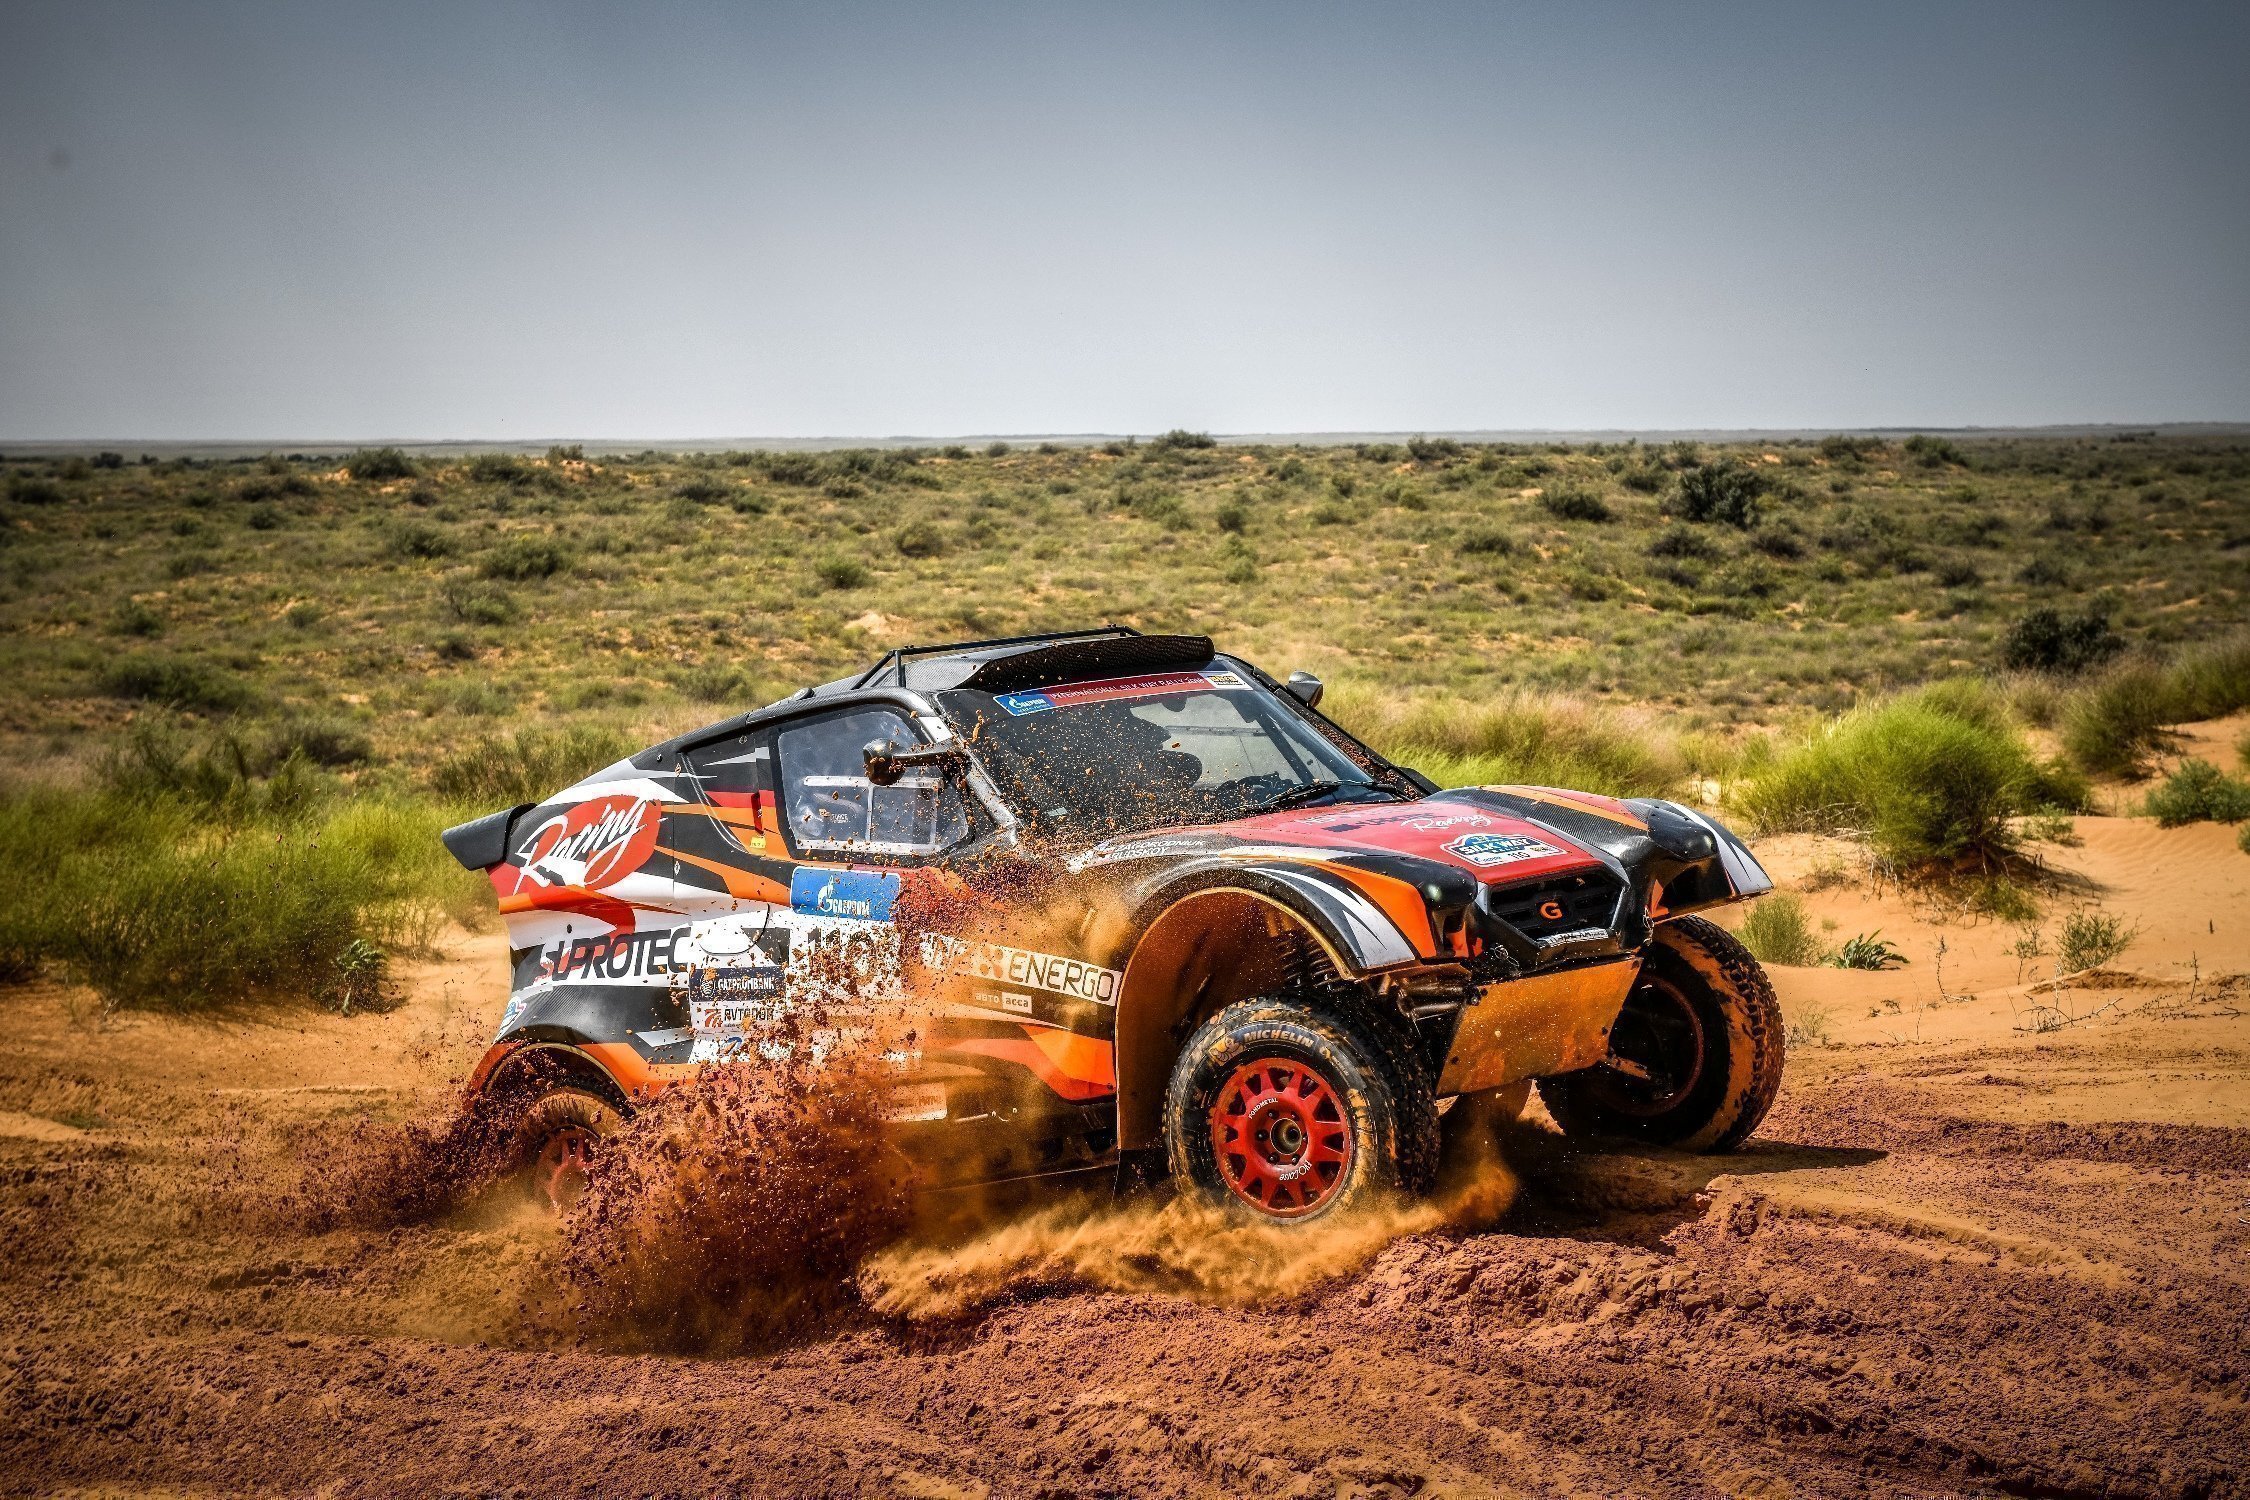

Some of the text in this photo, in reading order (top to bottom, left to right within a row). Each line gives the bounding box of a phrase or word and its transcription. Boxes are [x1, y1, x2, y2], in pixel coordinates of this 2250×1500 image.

[1121, 682, 1139, 691] SILK
[1140, 681, 1159, 690] WAY
[1400, 814, 1492, 832] Racing
[512, 797, 649, 896] Racing
[1459, 842, 1495, 855] SILK
[1498, 837, 1531, 849] WAY
[1540, 902, 1562, 920] G
[1007, 951, 1115, 1002] ENERGO
[1243, 1029, 1315, 1048] MICHELIN
[1248, 1097, 1279, 1119] FONDMETAL
